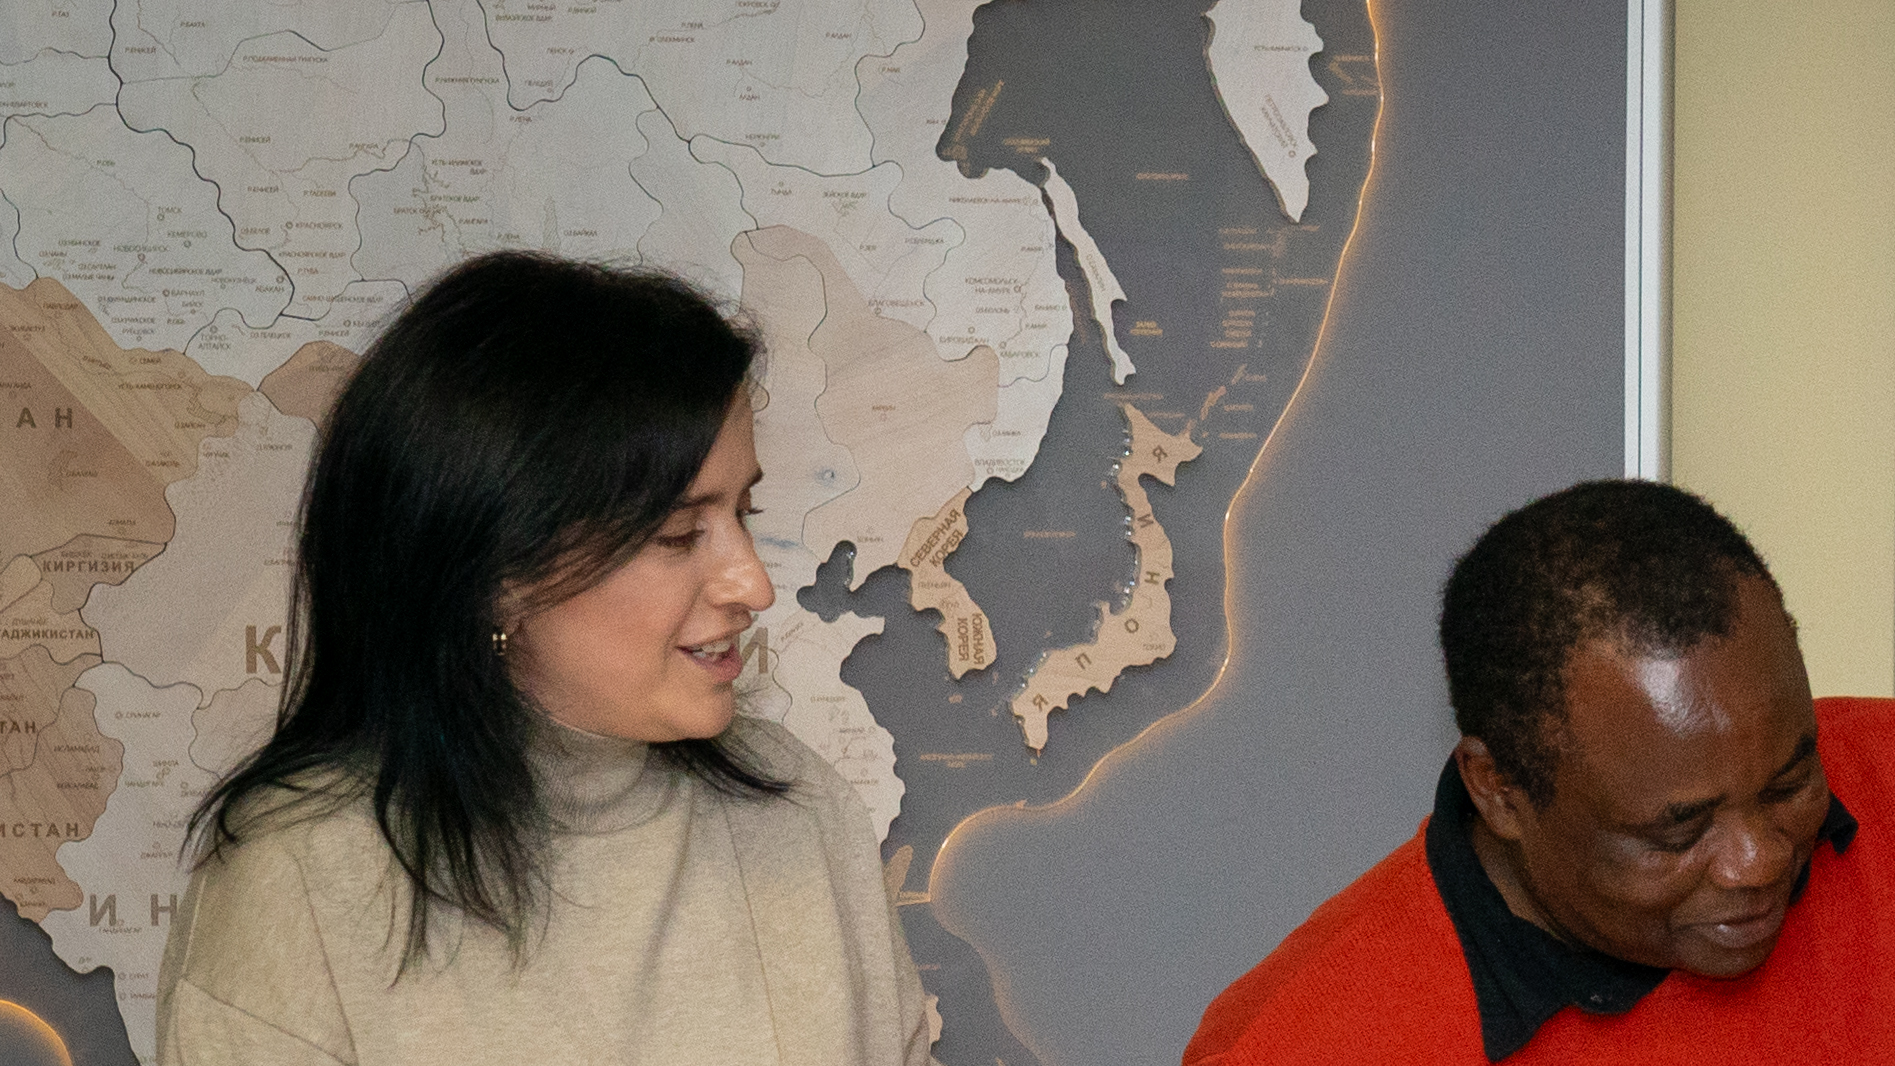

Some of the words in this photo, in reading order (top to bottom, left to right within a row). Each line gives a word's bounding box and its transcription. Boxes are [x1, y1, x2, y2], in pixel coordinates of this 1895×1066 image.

[910, 508, 961, 568] СЕВЕРНАЯ
[930, 530, 963, 567] КОРЕЯ
[43, 560, 135, 573] КИРГИЗИЯ
[0, 629, 94, 642] АДЖИКИСТАН
[958, 616, 969, 663] КОРЕЯ
[971, 612, 984, 665] ЮЖНАЯ
